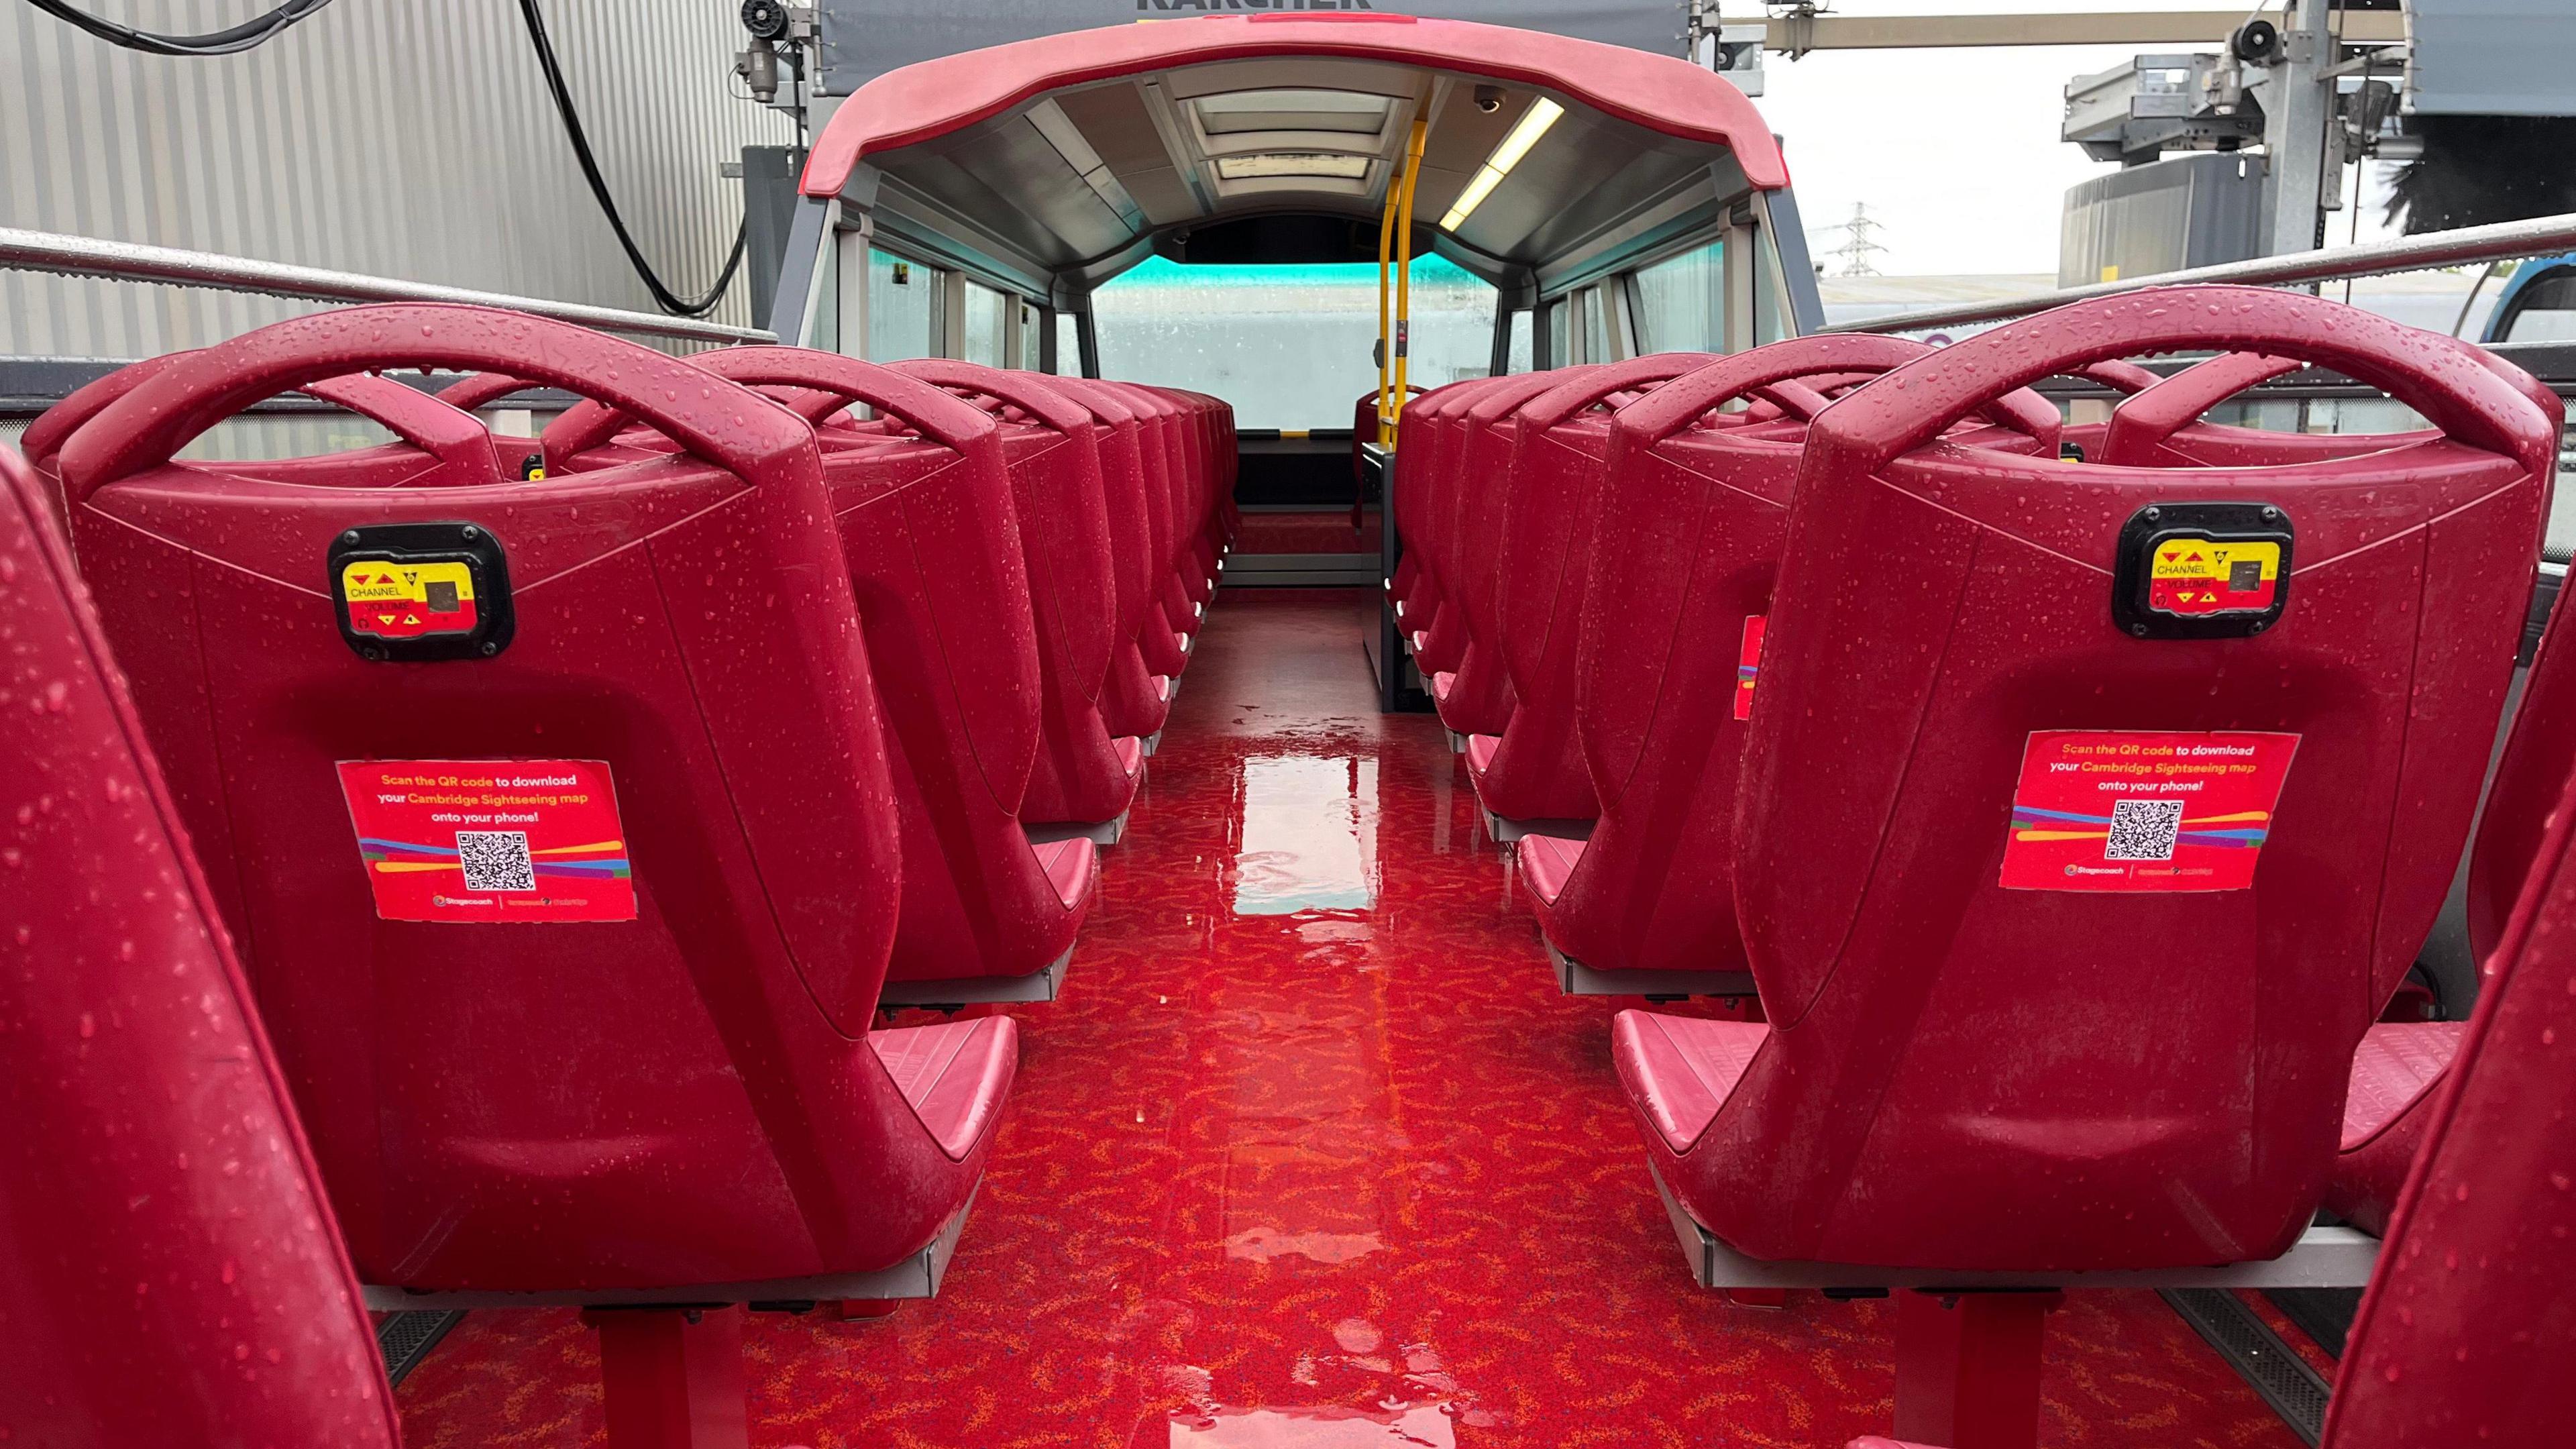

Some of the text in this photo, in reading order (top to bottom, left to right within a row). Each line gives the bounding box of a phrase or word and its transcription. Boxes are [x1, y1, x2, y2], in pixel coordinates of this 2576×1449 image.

[2157, 566, 2207, 574] CHANNEL
[2167, 579, 2211, 588] VOLUME
[351, 588, 402, 597] CHANNEL
[366, 601, 409, 611] VOLUME
[2063, 744, 2255, 756] Scan the QR code to download
[2050, 761, 2256, 775] your Cambridge Sightseeing map
[382, 774, 577, 788] Scan the QR code to download
[2098, 780, 2204, 794] onto your phone!
[377, 793, 588, 807] your Cambridge Sightseeing map
[431, 812, 539, 824] onto your phone!
